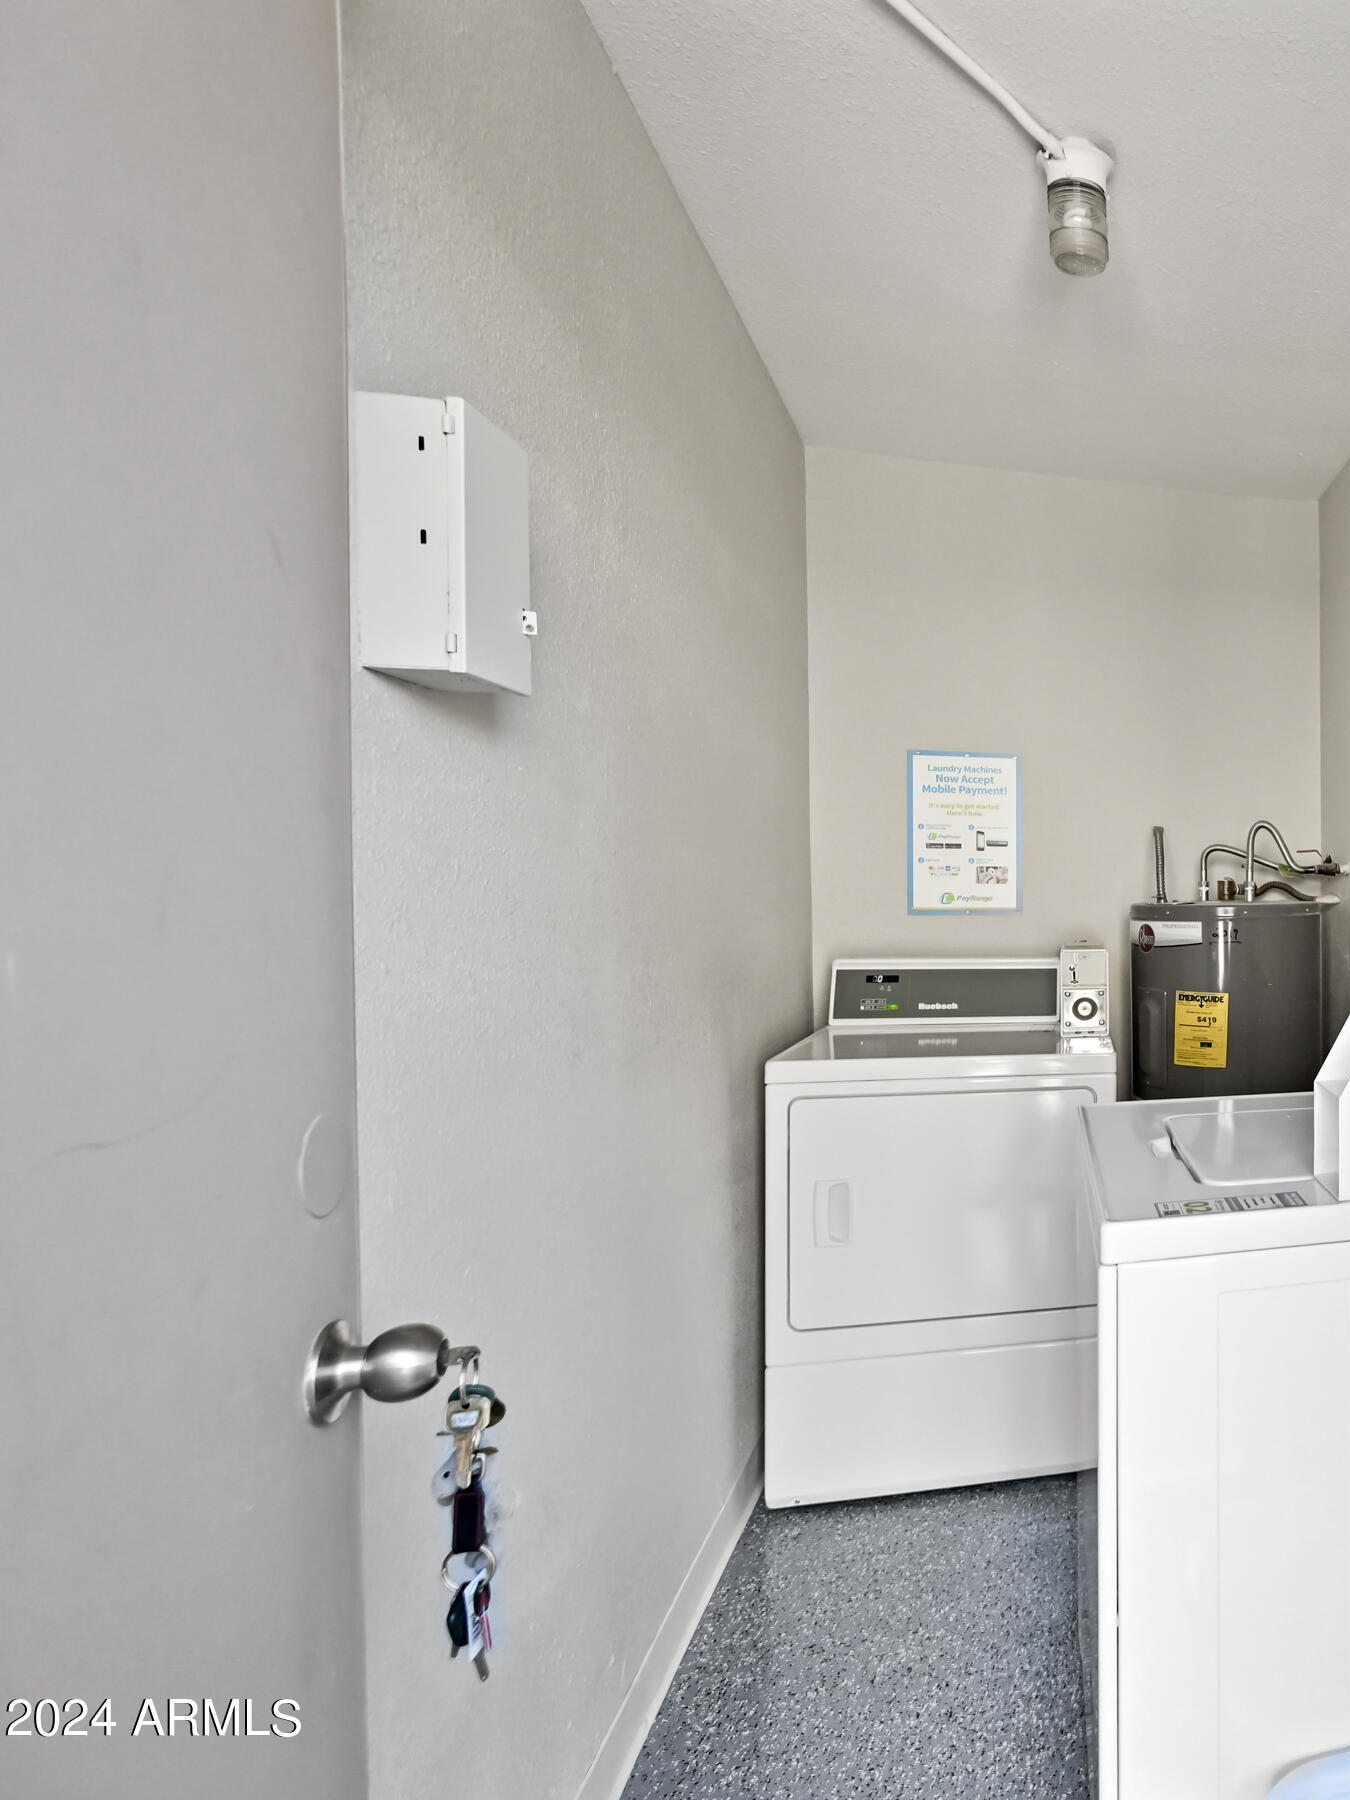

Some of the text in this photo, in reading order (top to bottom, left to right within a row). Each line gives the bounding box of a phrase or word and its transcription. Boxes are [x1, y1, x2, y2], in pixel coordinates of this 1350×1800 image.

[927, 764, 1002, 774] Laundry Machines
[935, 774, 994, 785] Now Accept
[922, 784, 1007, 796] Mobile Payment!
[1178, 993, 1225, 1004] ENERGYGUIDE
[918, 1002, 959, 1010] Huebsch
[1197, 1016, 1217, 1024] $419
